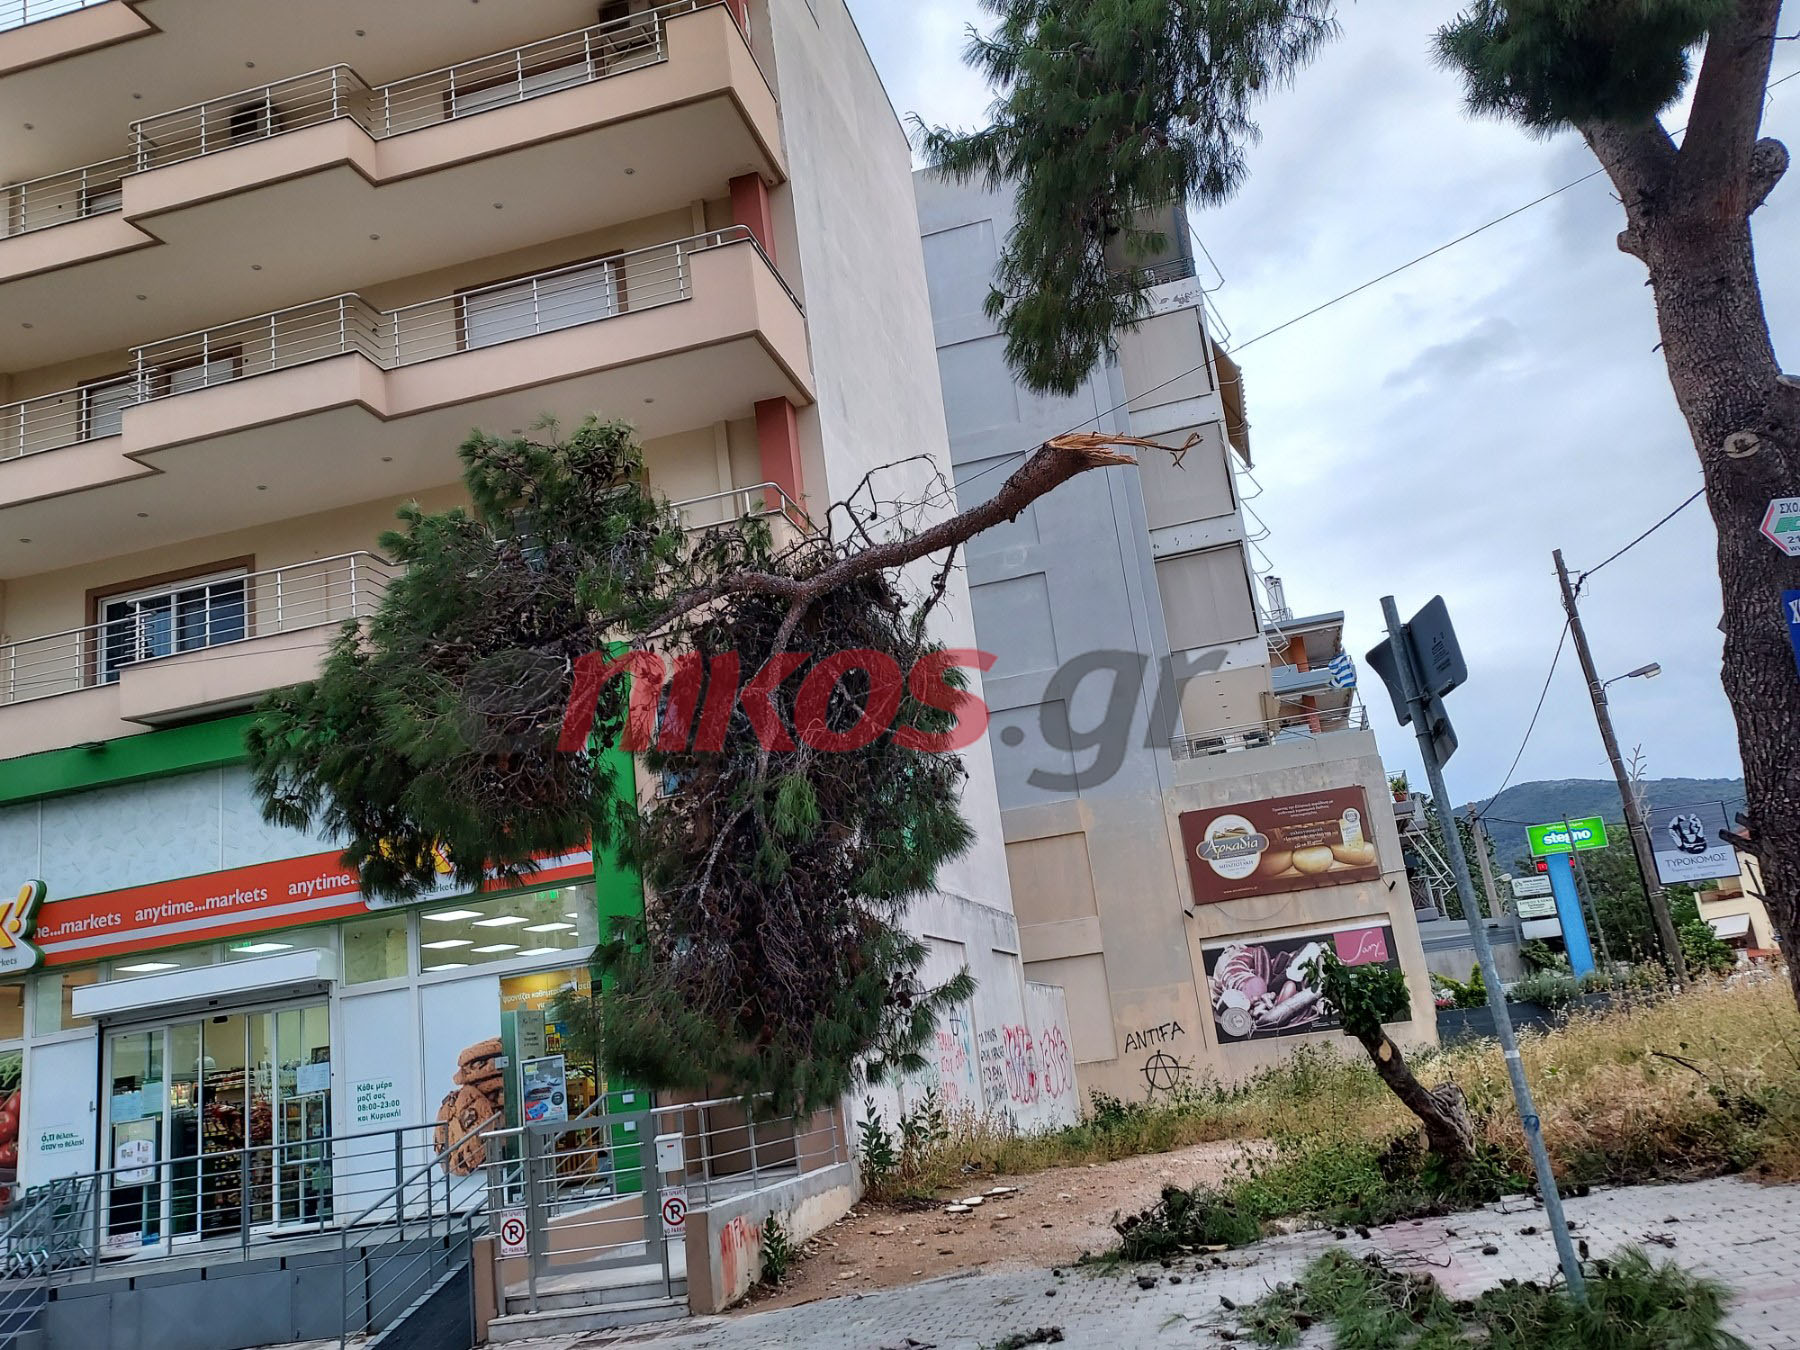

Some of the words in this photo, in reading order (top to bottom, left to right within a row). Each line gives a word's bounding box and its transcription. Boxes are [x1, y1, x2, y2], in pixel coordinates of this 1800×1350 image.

[1780, 502, 1800, 514] ΣΧΟ
[1665, 852, 1728, 868] ΤΥΡΟΚΟΜΟΣ
[135, 888, 267, 922] anytime...markets
[1125, 1021, 1185, 1053] ANTIFA
